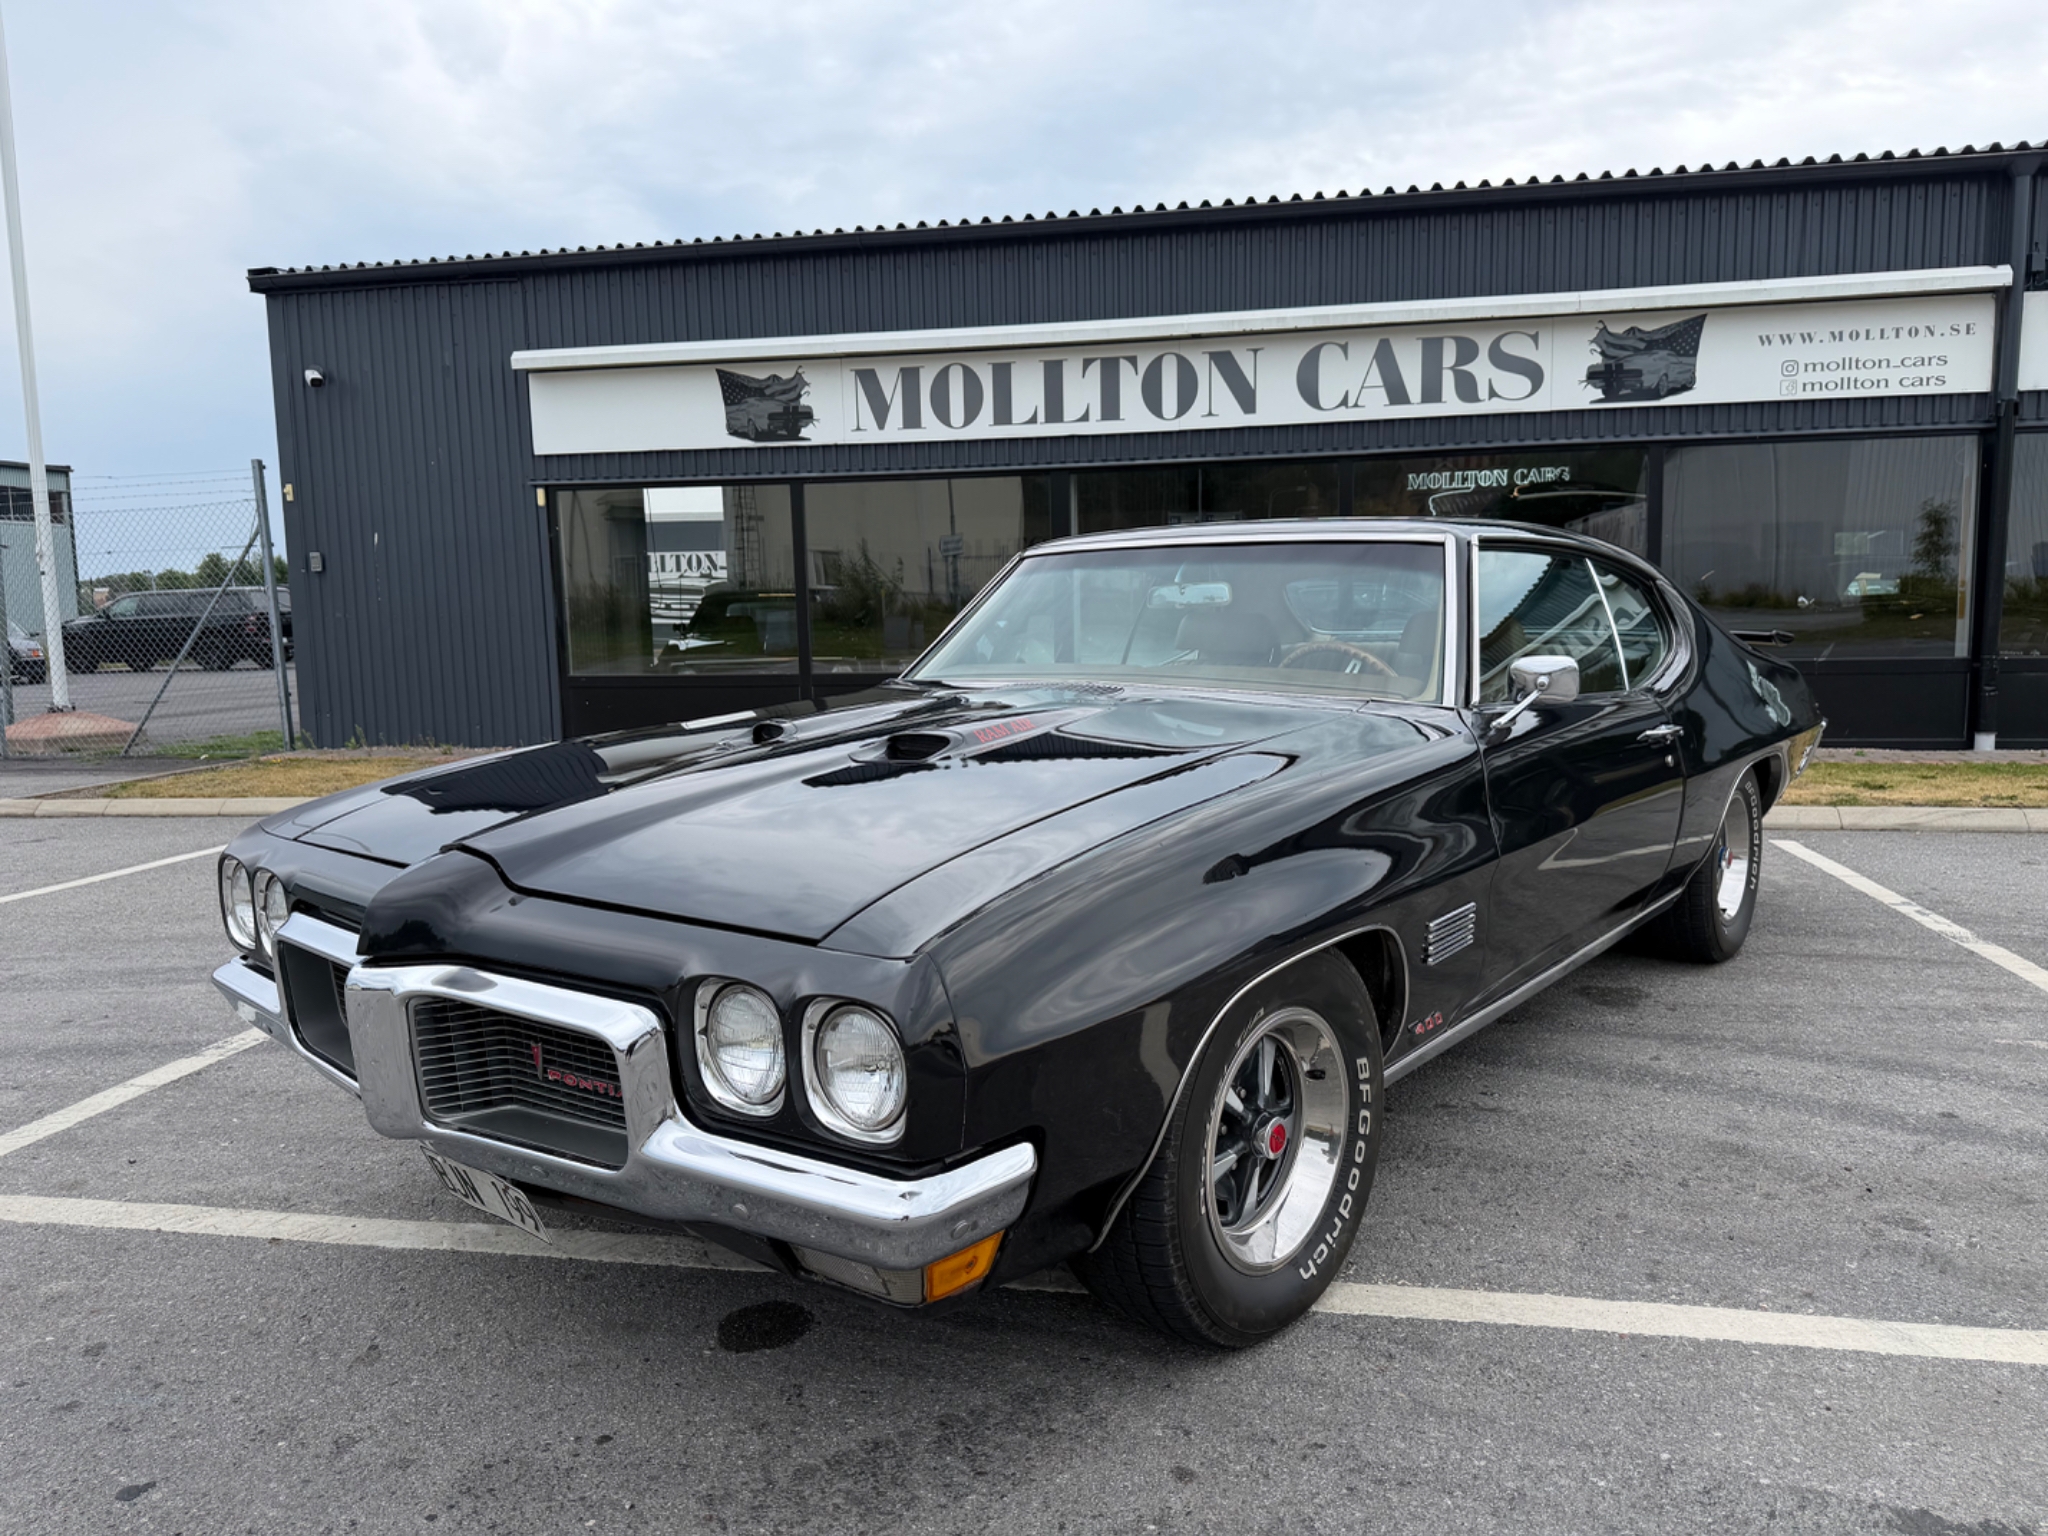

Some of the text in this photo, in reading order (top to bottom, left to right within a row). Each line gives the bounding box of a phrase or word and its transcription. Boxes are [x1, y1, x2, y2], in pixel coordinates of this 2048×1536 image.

[1758, 322, 1977, 347] WWW.MOLLTON.SE
[1803, 354, 1948, 373] mollton_cars
[850, 330, 1545, 431] MOLLTON CARS
[1802, 373, 1947, 393] mollton cars
[1407, 469, 1509, 490] MOLLTON
[974, 717, 1037, 744] RAM AIR
[1415, 1012, 1443, 1035] 400
[1300, 1057, 1371, 1280] BFGoodrich
[491, 1181, 540, 1232] 199
